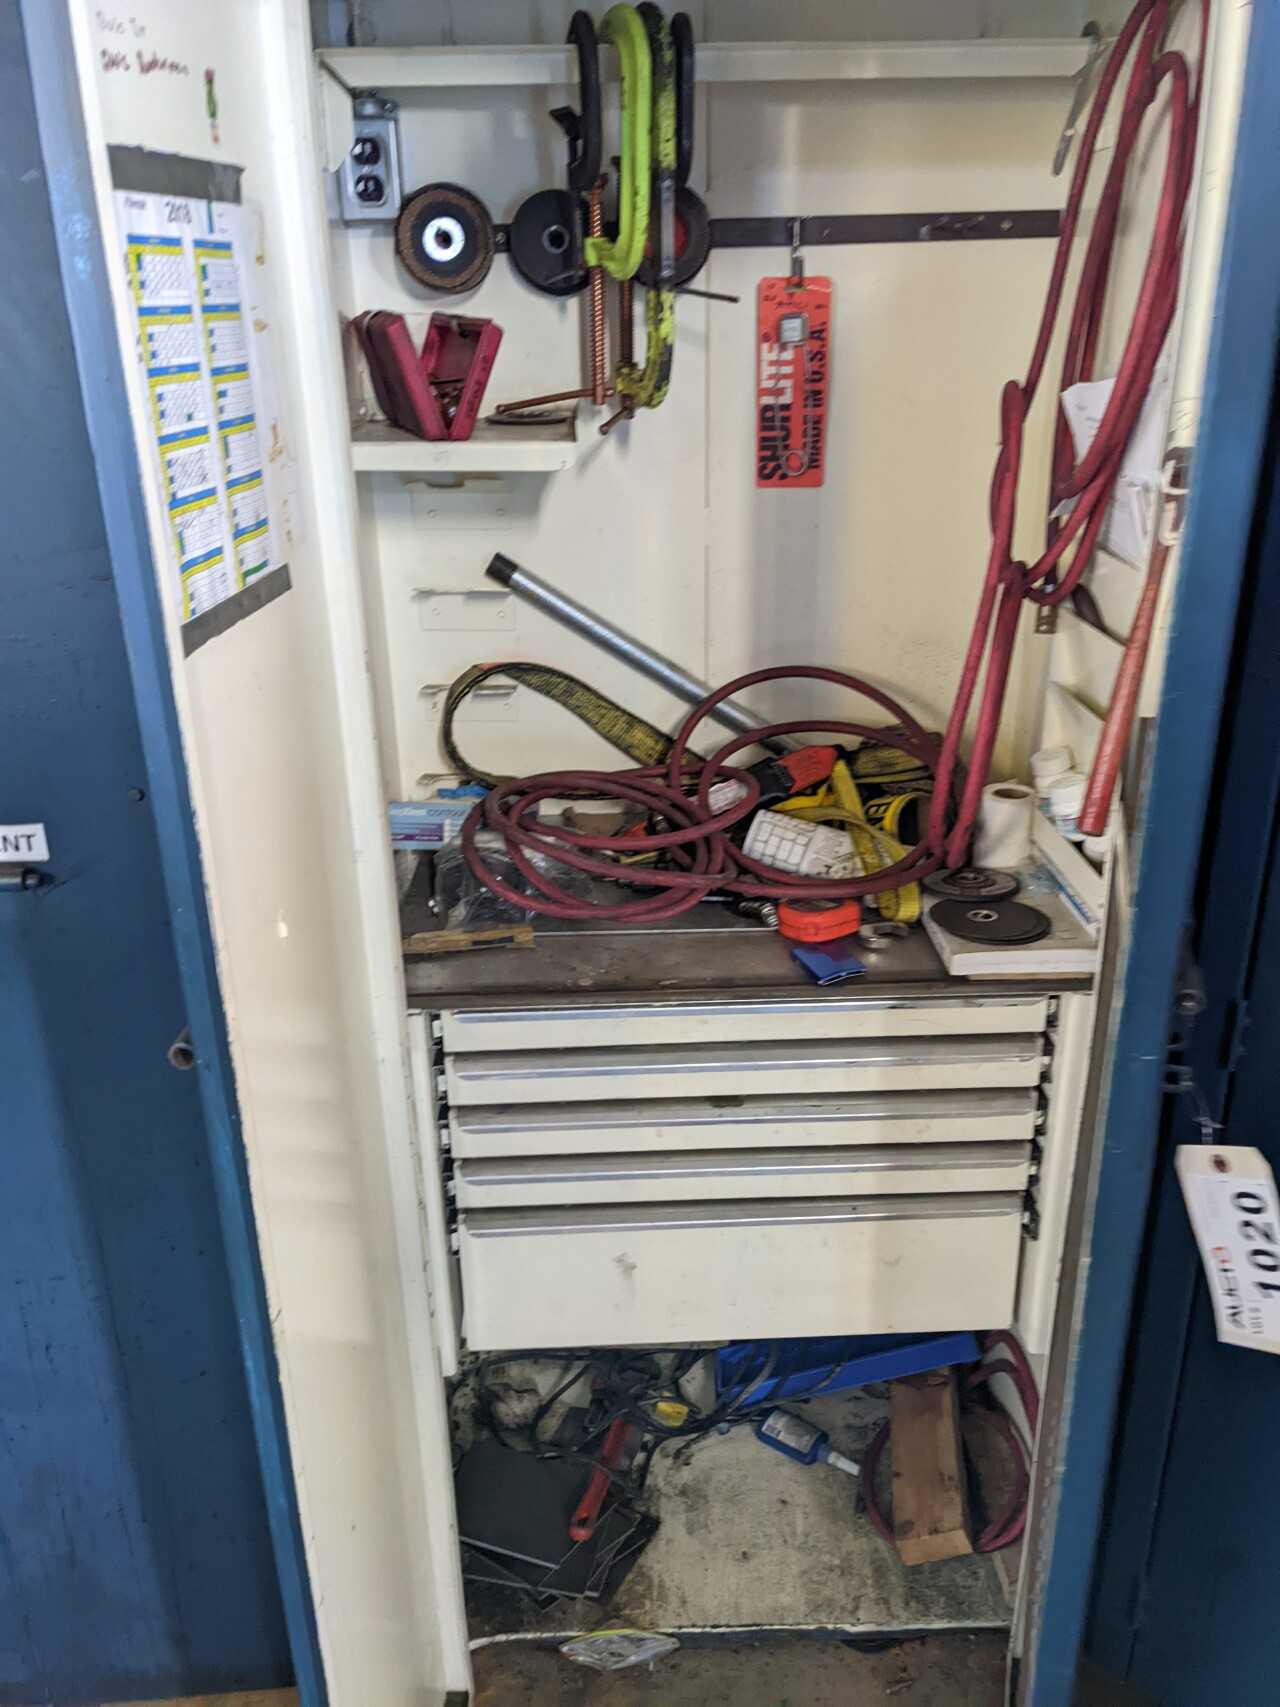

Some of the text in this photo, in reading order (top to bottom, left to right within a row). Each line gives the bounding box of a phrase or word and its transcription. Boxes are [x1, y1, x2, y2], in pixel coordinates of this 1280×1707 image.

[759, 342, 795, 480] SHURLITE
[802, 321, 827, 469] MADE IN U.S.A.
[0, 833, 36, 853] NT
[1231, 1191, 1280, 1299] 1020
